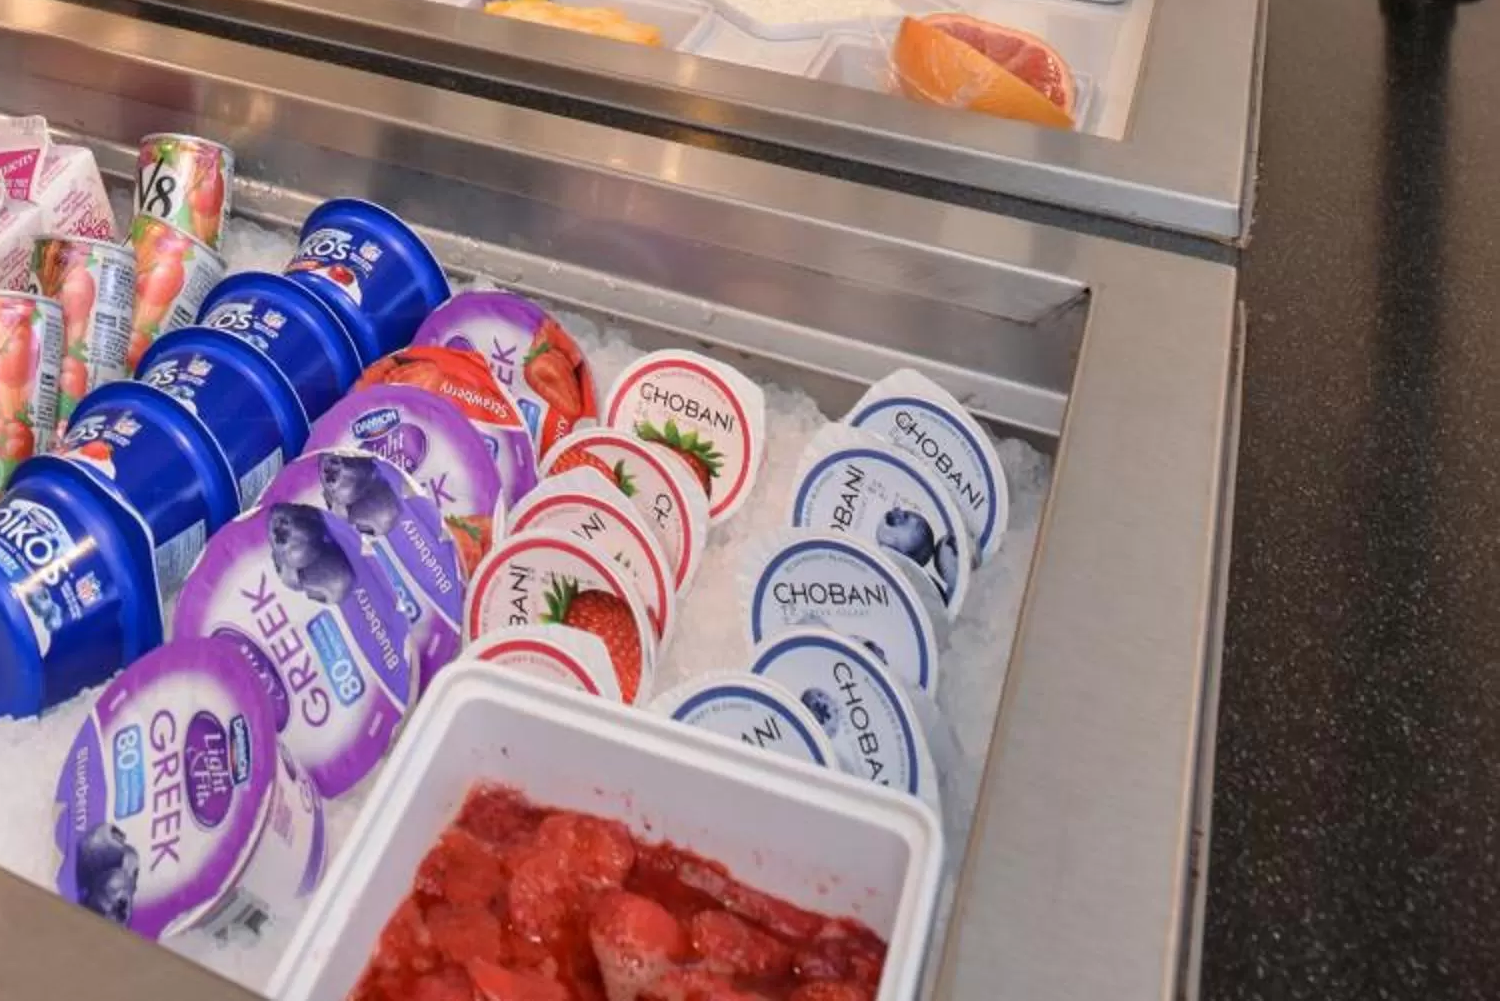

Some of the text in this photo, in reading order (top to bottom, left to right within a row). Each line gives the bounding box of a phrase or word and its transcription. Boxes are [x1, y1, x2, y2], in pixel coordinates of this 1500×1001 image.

[439, 379, 510, 420] Strawberry
[639, 382, 736, 434] CHOBANI
[894, 410, 986, 512] CHOBANI
[830, 463, 866, 532] BANI
[401, 518, 453, 595] Blueberry
[508, 563, 532, 627] BANI
[772, 582, 890, 609] CHOBANI
[240, 571, 330, 727] GREEK
[354, 587, 400, 671] Blueberry
[331, 658, 362, 700] 80
[115, 728, 140, 770] 80
[832, 661, 889, 786] CHOBA
[74, 745, 91, 832] Blueberry
[149, 709, 183, 872] GREEK
[193, 769, 212, 808] Fit
[203, 732, 230, 795] Light
